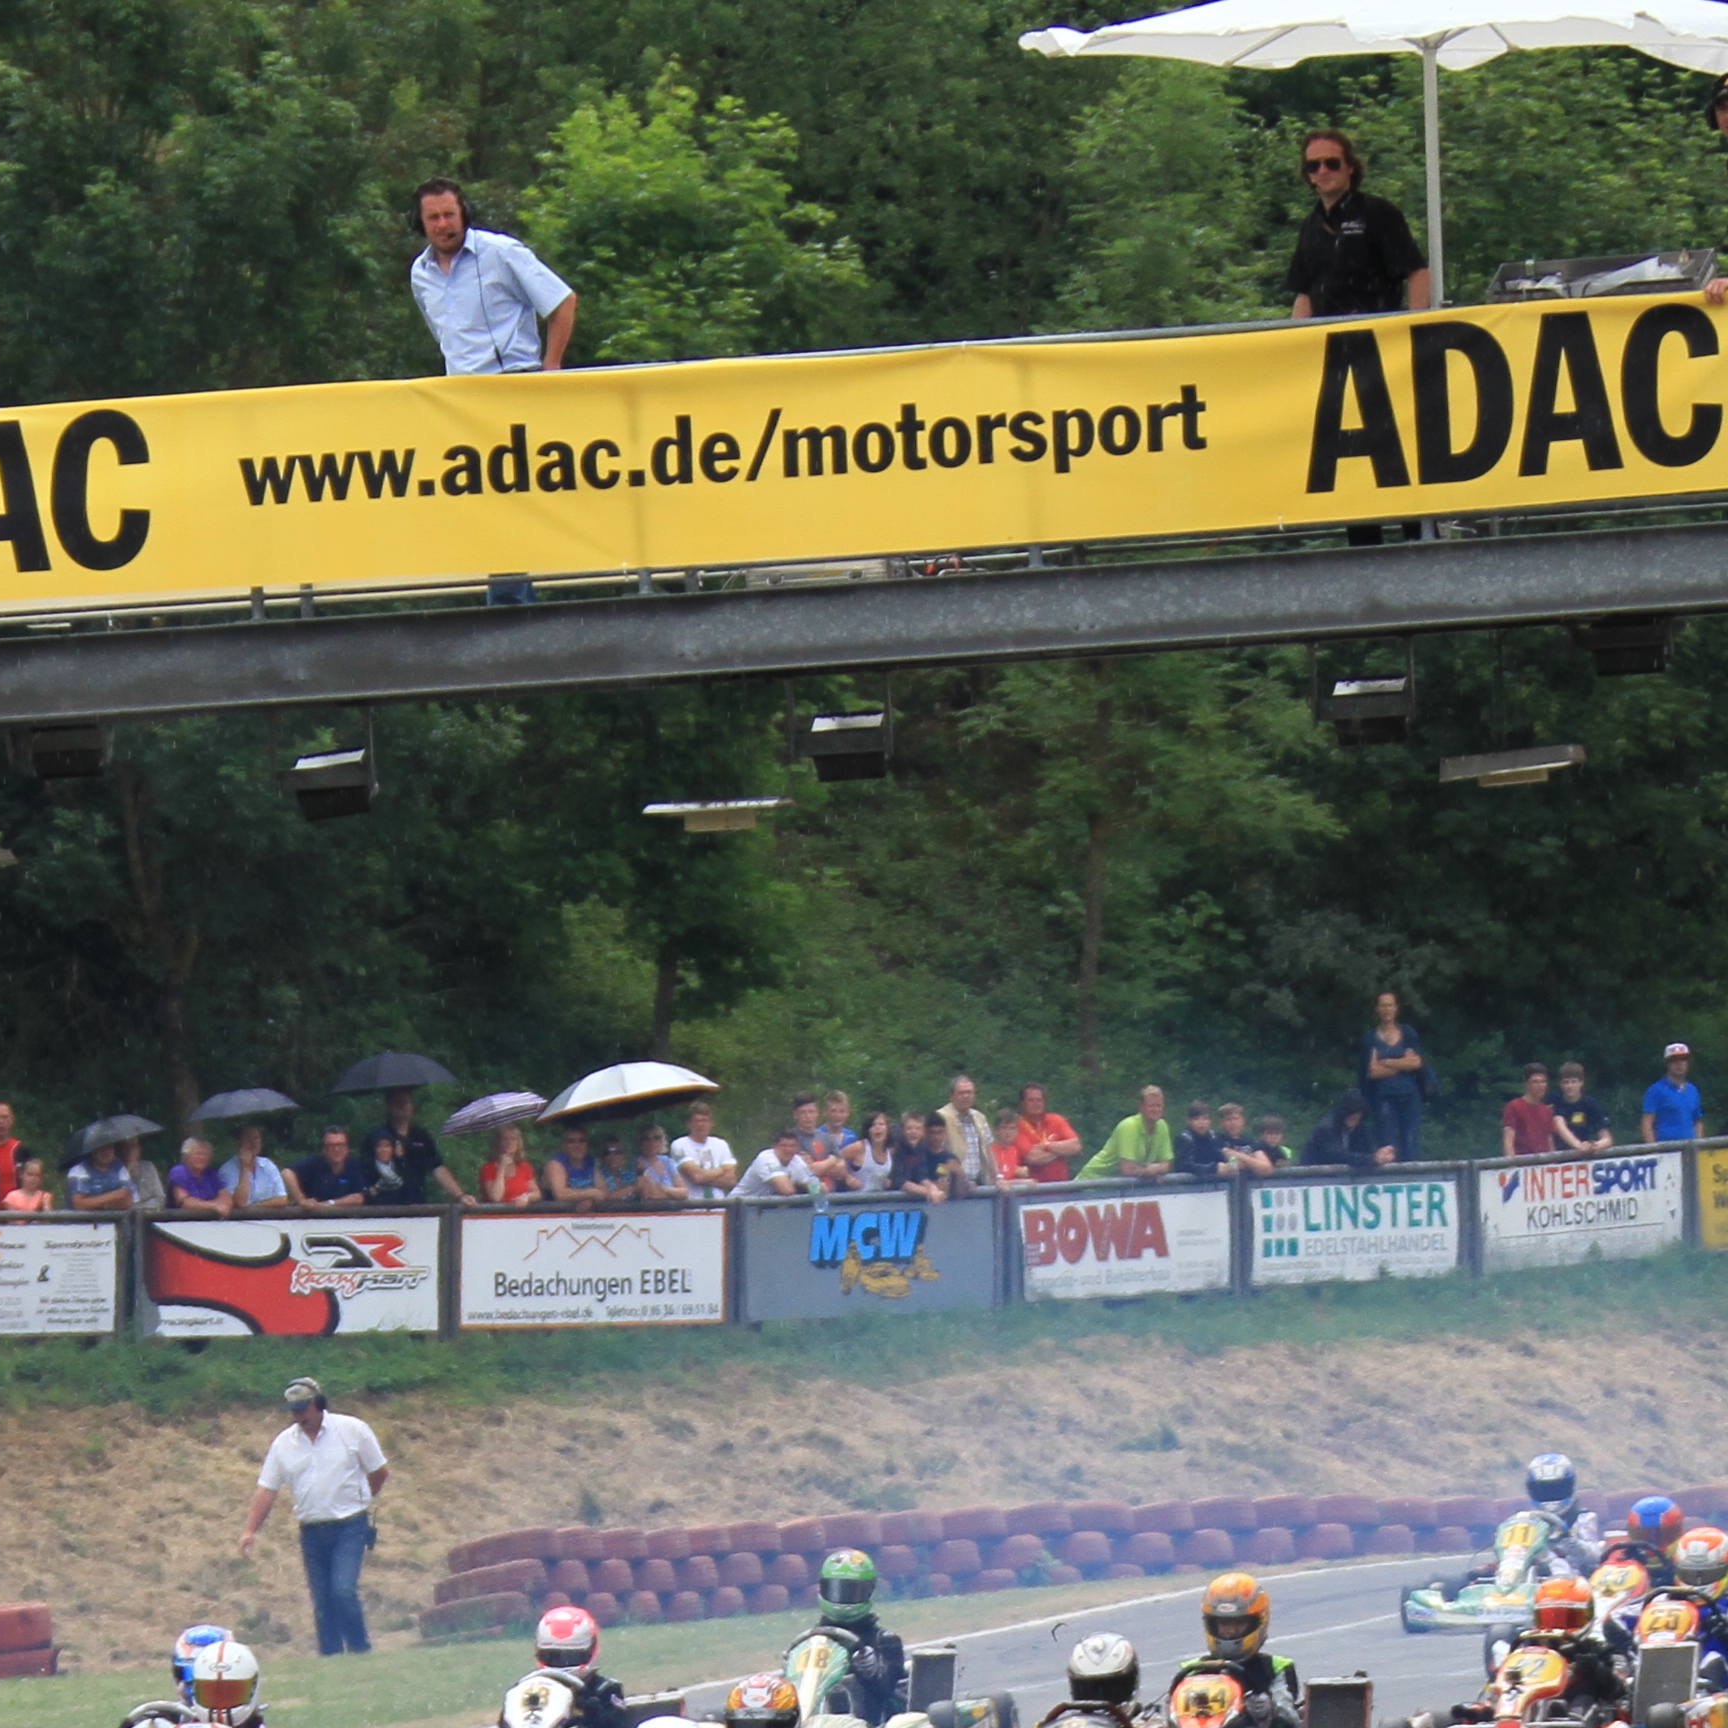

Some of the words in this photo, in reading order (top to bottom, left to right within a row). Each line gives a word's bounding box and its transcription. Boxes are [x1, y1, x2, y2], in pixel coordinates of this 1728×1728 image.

[239, 384, 1207, 506] www.adac.de/motorsport
[1306, 303, 1723, 494] ADAC
[1523, 1158, 1658, 1202] INTERSPORT
[1302, 1183, 1448, 1232] LINSTER
[1527, 1197, 1639, 1229] KOHLSCHMID
[809, 1210, 927, 1265] MCW
[1023, 1201, 1169, 1267] BOWA
[1305, 1233, 1448, 1256] EDELSTAHLHANDEL
[494, 1271, 632, 1302] Bedachungen
[640, 1268, 692, 1294] EBEL
